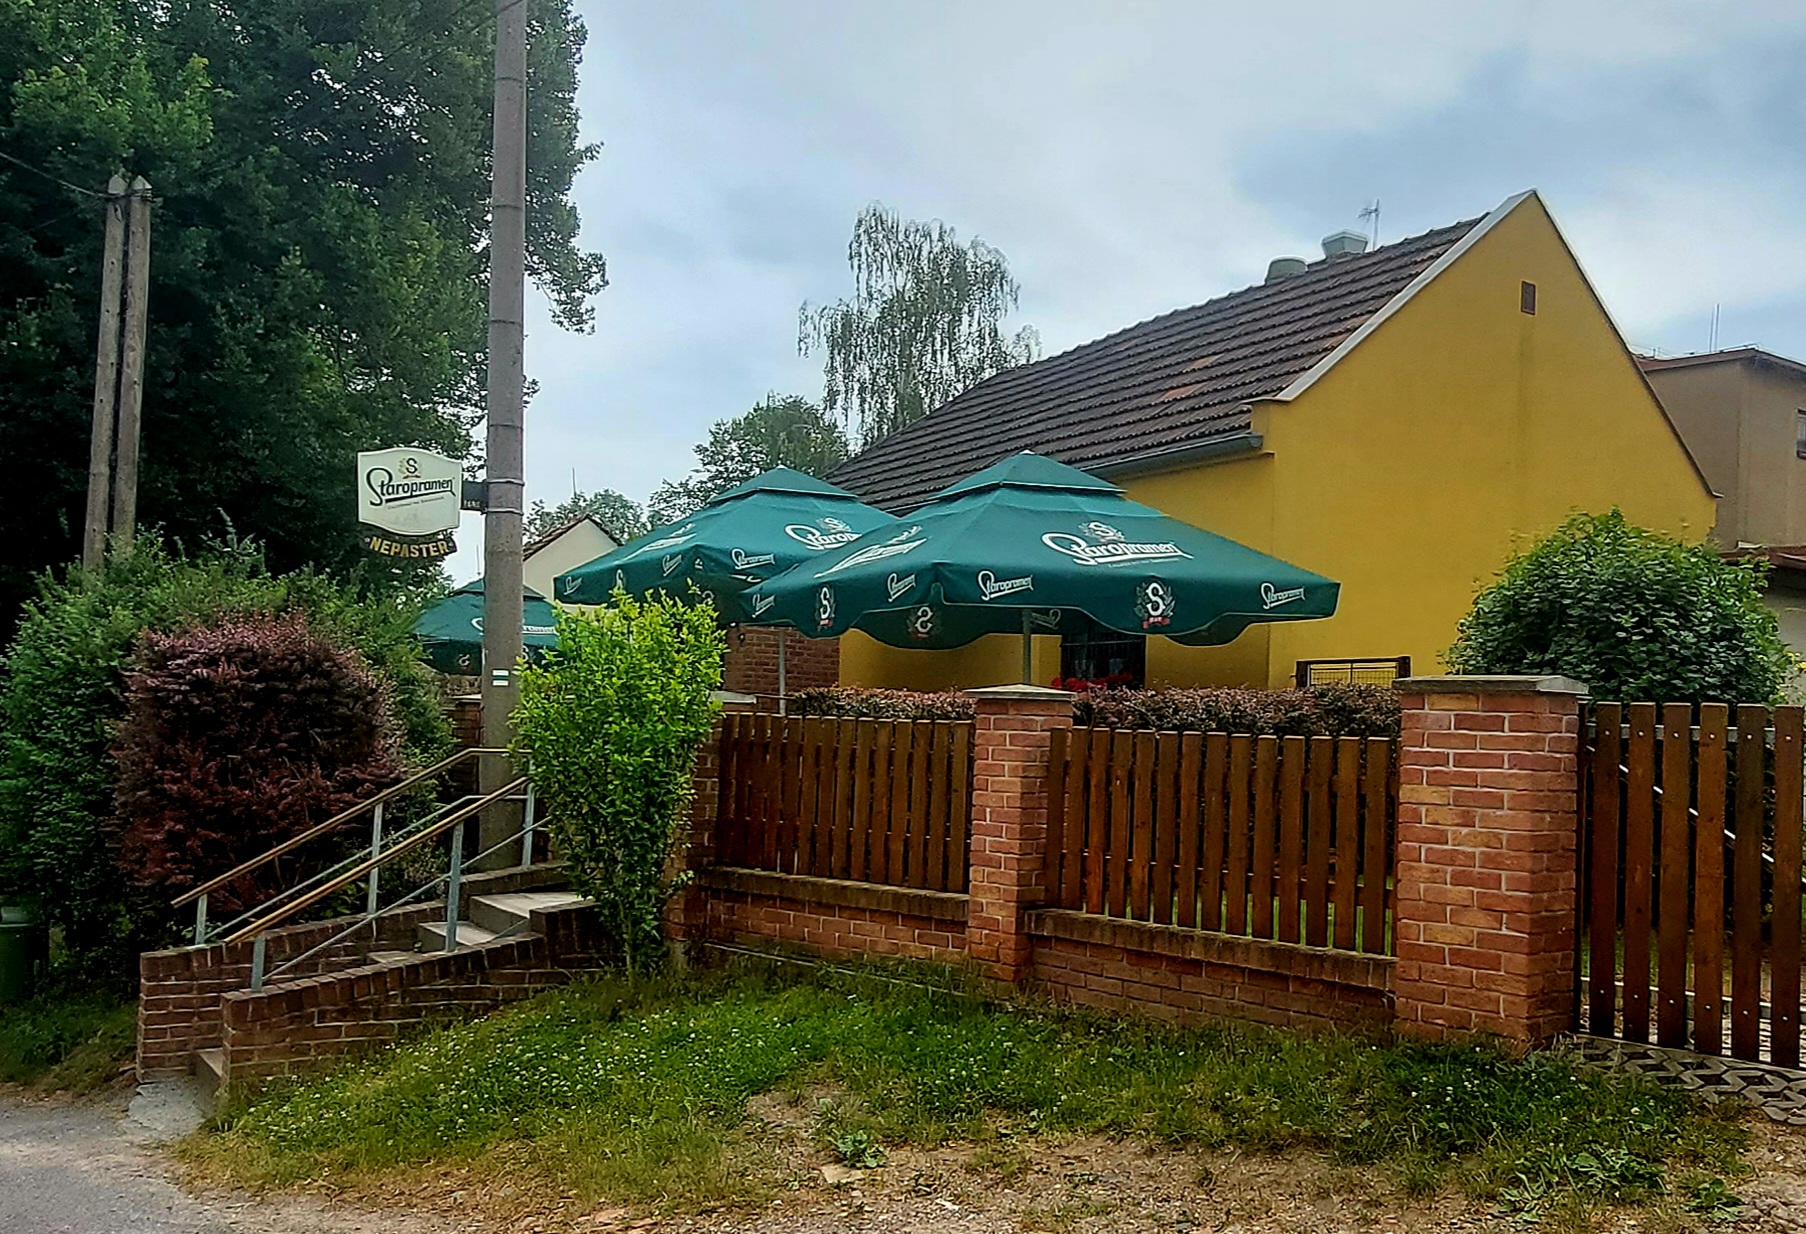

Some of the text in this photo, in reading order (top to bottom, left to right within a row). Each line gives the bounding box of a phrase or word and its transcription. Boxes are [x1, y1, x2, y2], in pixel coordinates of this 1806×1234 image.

[406, 458, 418, 474] S
[366, 467, 456, 506] Staropramen
[369, 537, 449, 557] NEPASTER
[1041, 533, 1194, 565] Staropramen
[1146, 582, 1166, 616] S
